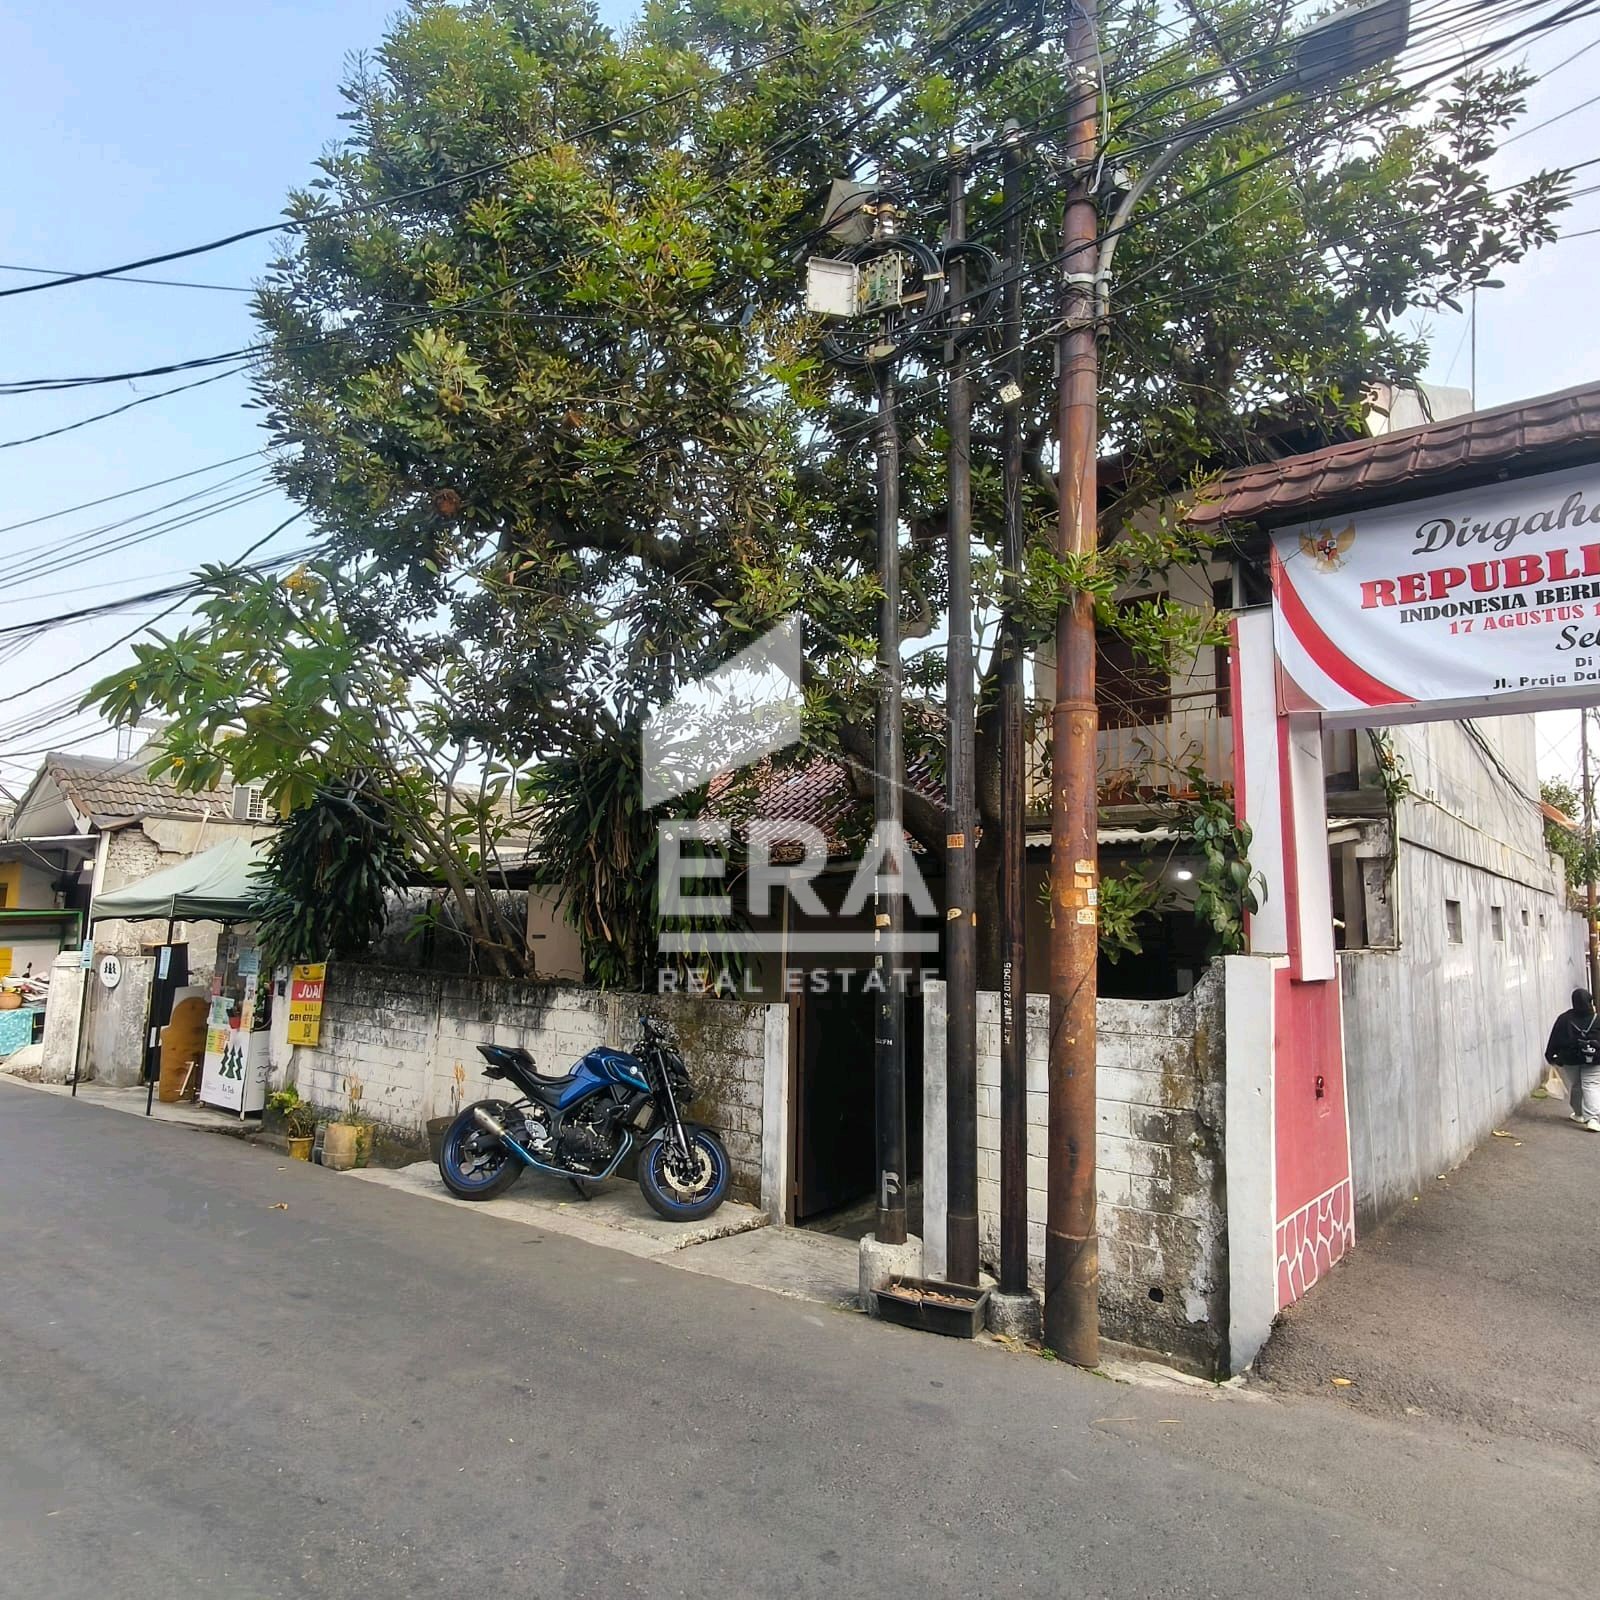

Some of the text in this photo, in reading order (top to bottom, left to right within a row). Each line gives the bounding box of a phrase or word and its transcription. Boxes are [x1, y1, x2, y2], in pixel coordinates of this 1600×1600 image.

[1400, 593, 1528, 624] INDONESIA
[1448, 618, 1475, 635] 17
[1483, 604, 1585, 631] AGUSTUS
[1575, 656, 1593, 668] Di
[1493, 678, 1513, 690] Jl.
[1519, 674, 1566, 687] Praja
